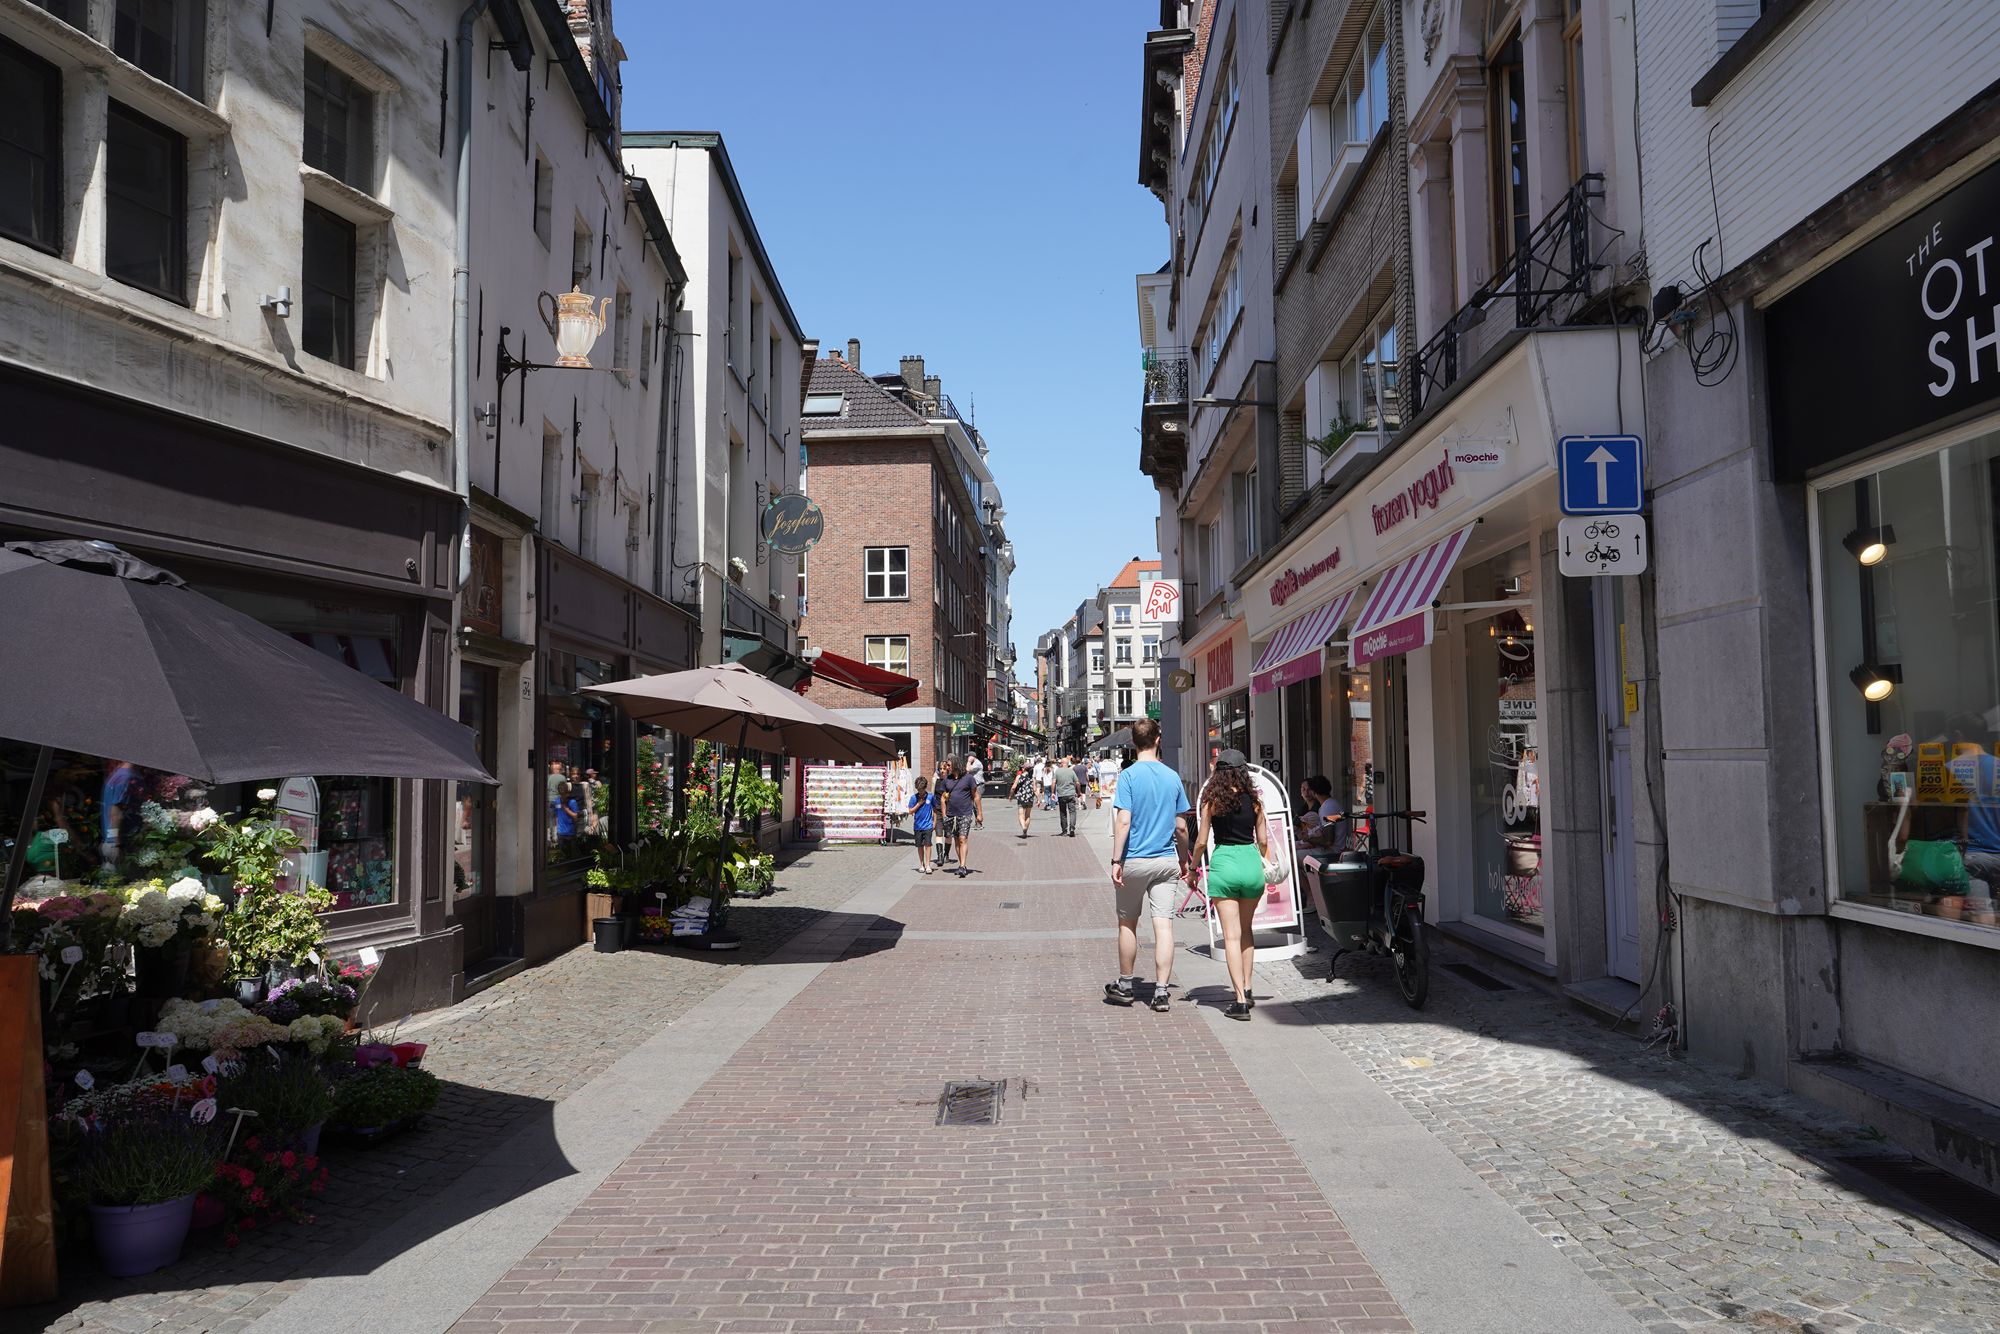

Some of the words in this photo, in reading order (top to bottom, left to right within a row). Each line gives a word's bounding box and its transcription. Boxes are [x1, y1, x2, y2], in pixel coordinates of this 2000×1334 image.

[1905, 220, 1944, 277] THE
[1921, 235, 1994, 321] OT
[1927, 306, 2000, 398] SH
[1455, 452, 1499, 464] moochie
[1371, 492, 1410, 536] frozen
[1407, 449, 1455, 519] yogurt
[768, 508, 819, 538] Jozefien
[1601, 563, 1607, 571] P
[1175, 676, 1187, 688] Z
[1920, 775, 1942, 784] POO
